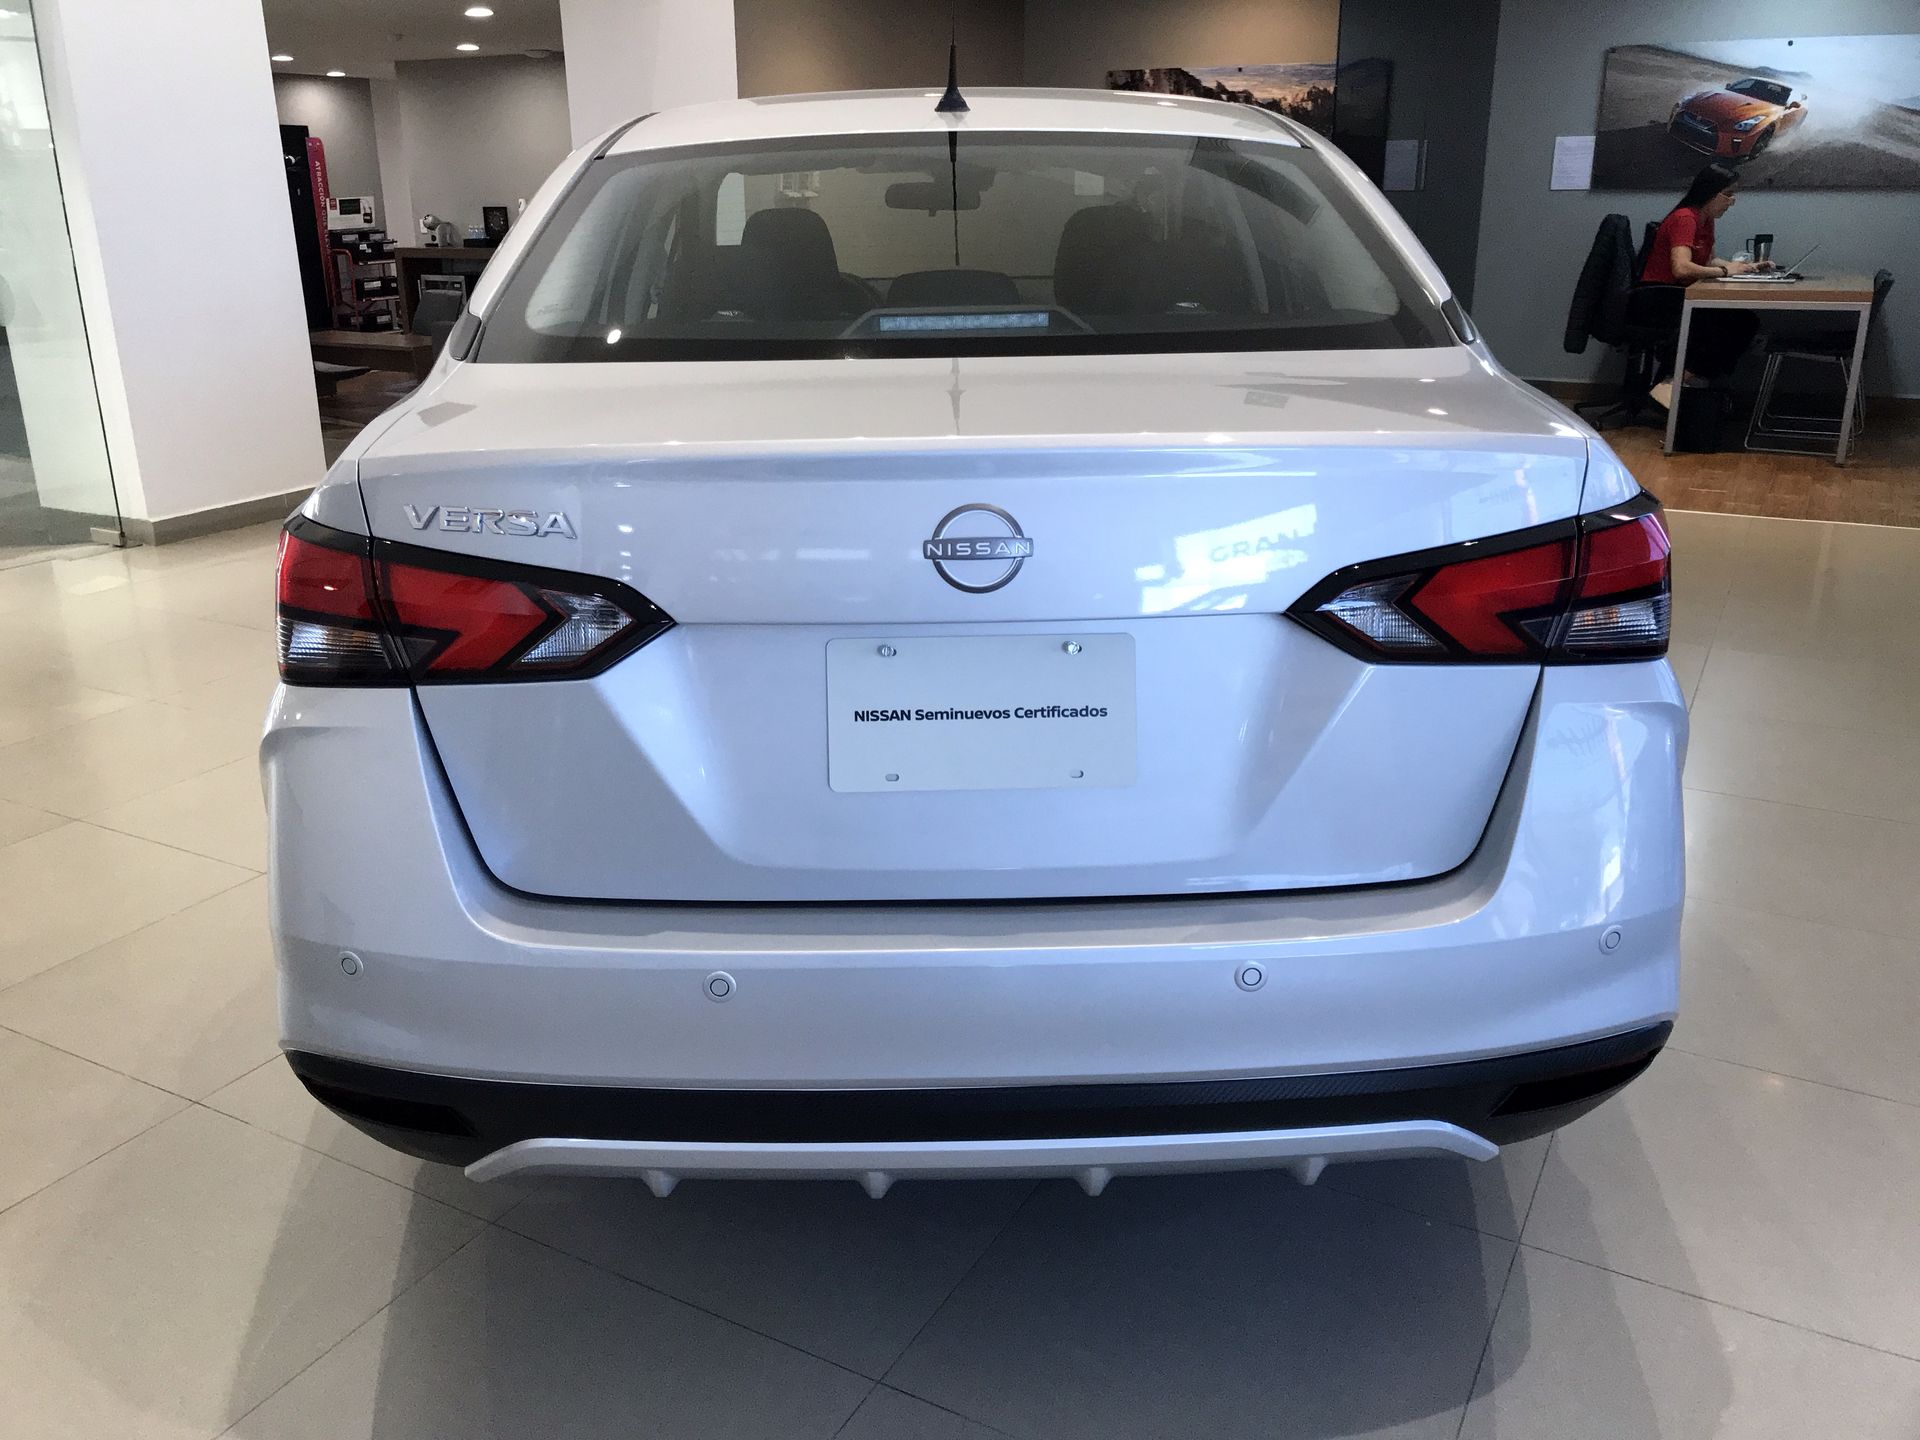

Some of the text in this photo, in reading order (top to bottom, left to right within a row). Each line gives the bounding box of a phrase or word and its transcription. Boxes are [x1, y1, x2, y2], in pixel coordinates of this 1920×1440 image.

[314, 160, 327, 208] ATRACCIÓN
[403, 504, 577, 540] VERSA
[926, 541, 1031, 557] NISSAN
[854, 705, 1108, 722] NISSAN Seminuevos Certificados
